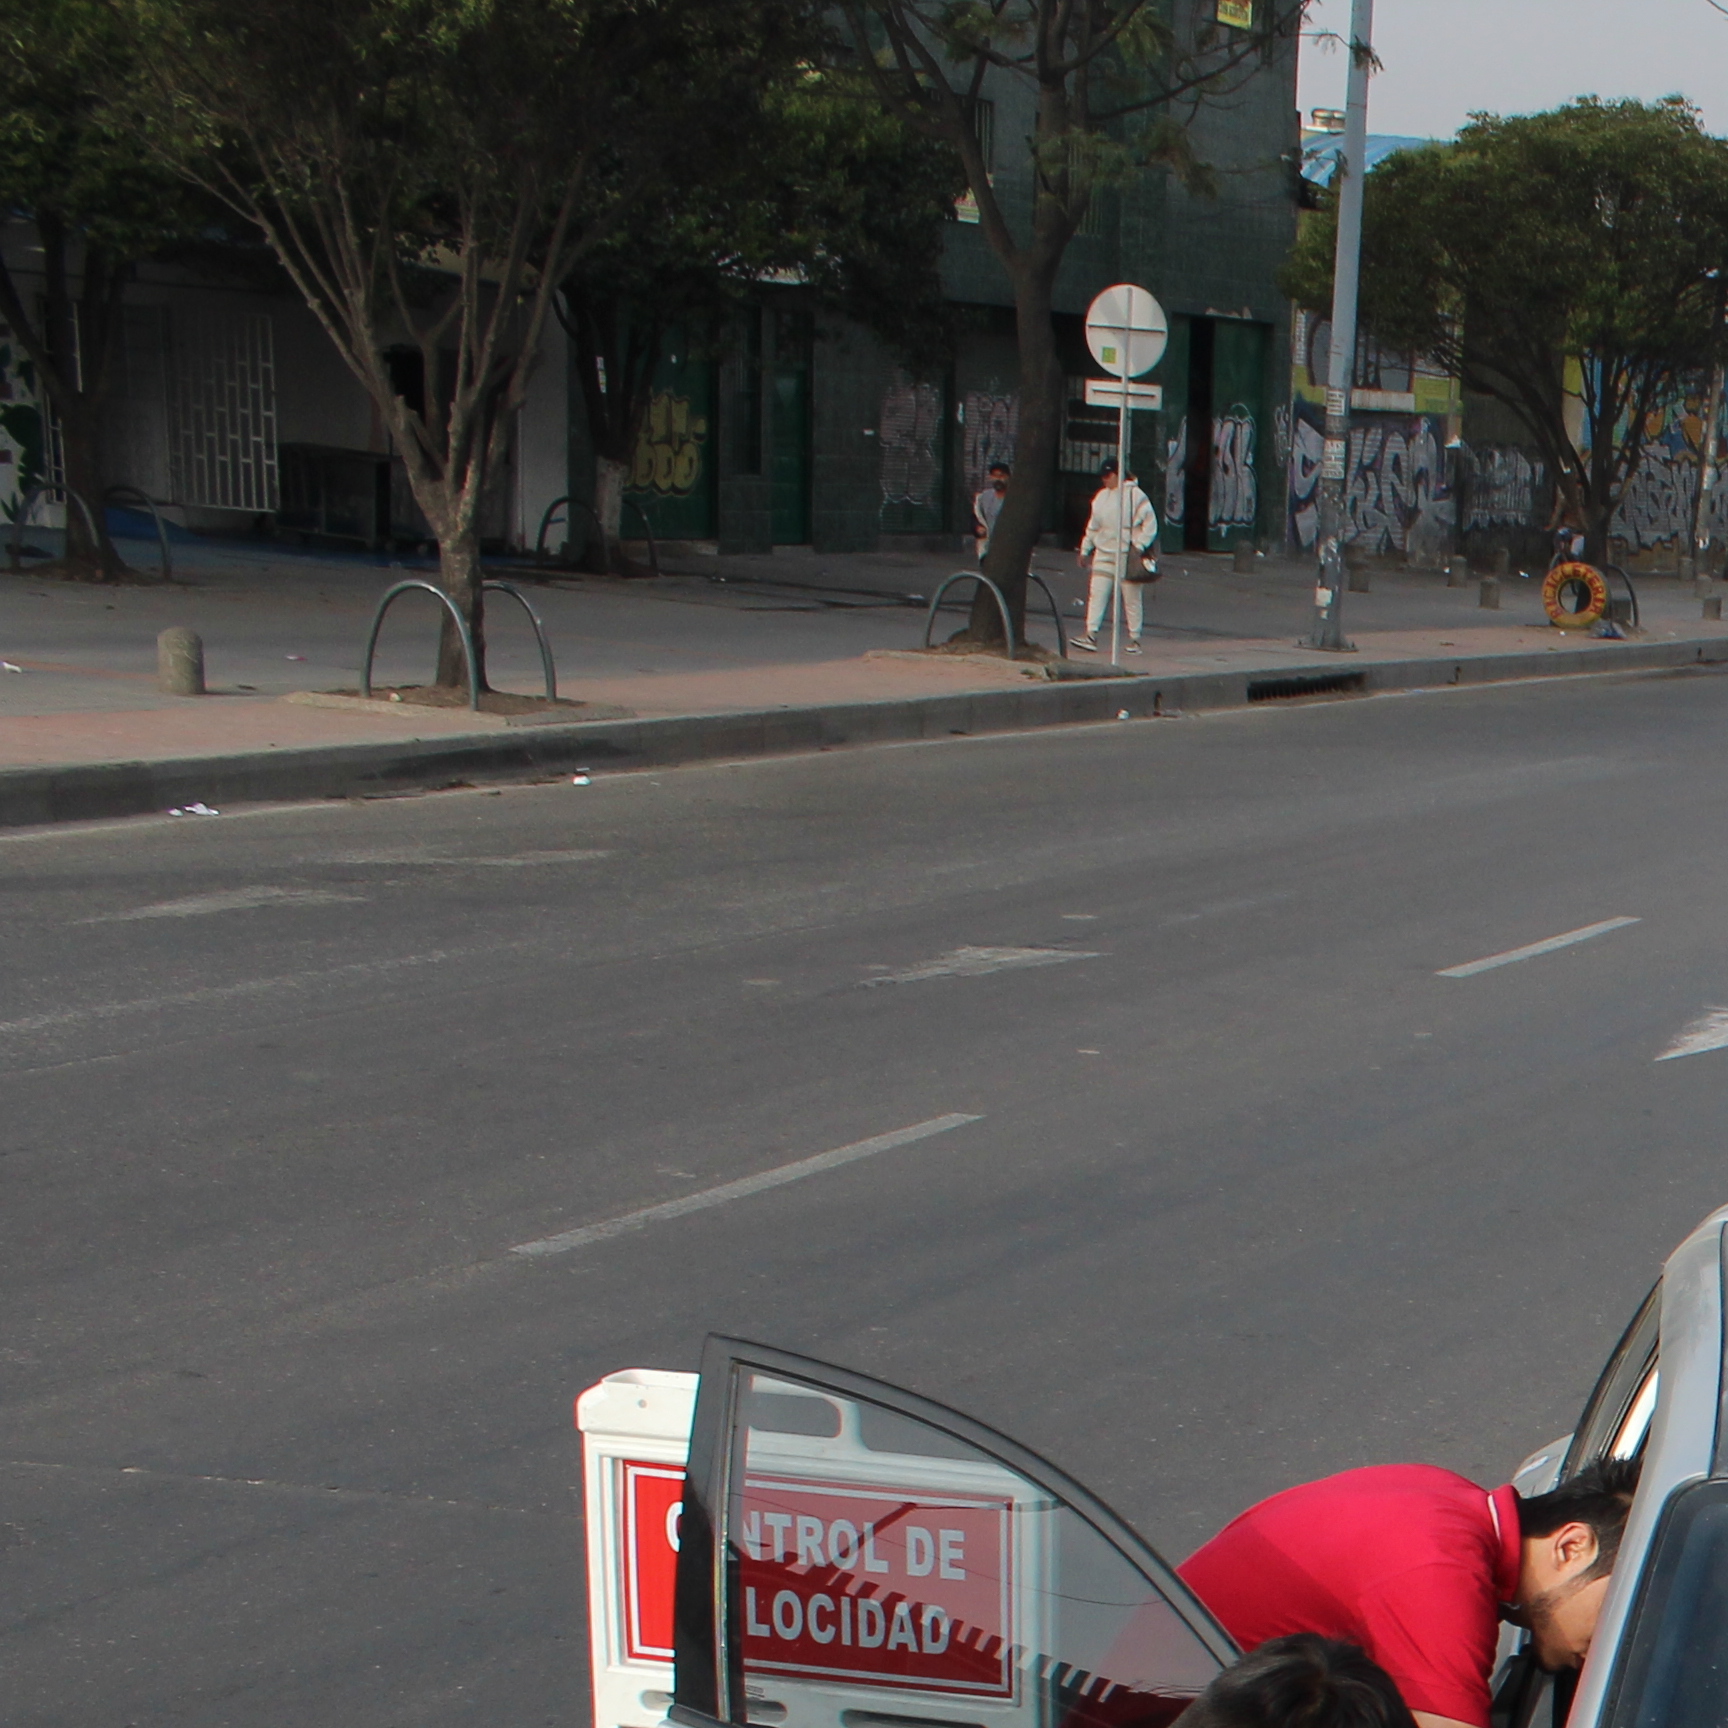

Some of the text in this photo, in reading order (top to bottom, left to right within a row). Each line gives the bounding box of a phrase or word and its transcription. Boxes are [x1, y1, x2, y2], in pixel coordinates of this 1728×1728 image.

[665, 1502, 966, 1581] CNTROL DE
[745, 1586, 951, 1655] LOCIDAD
